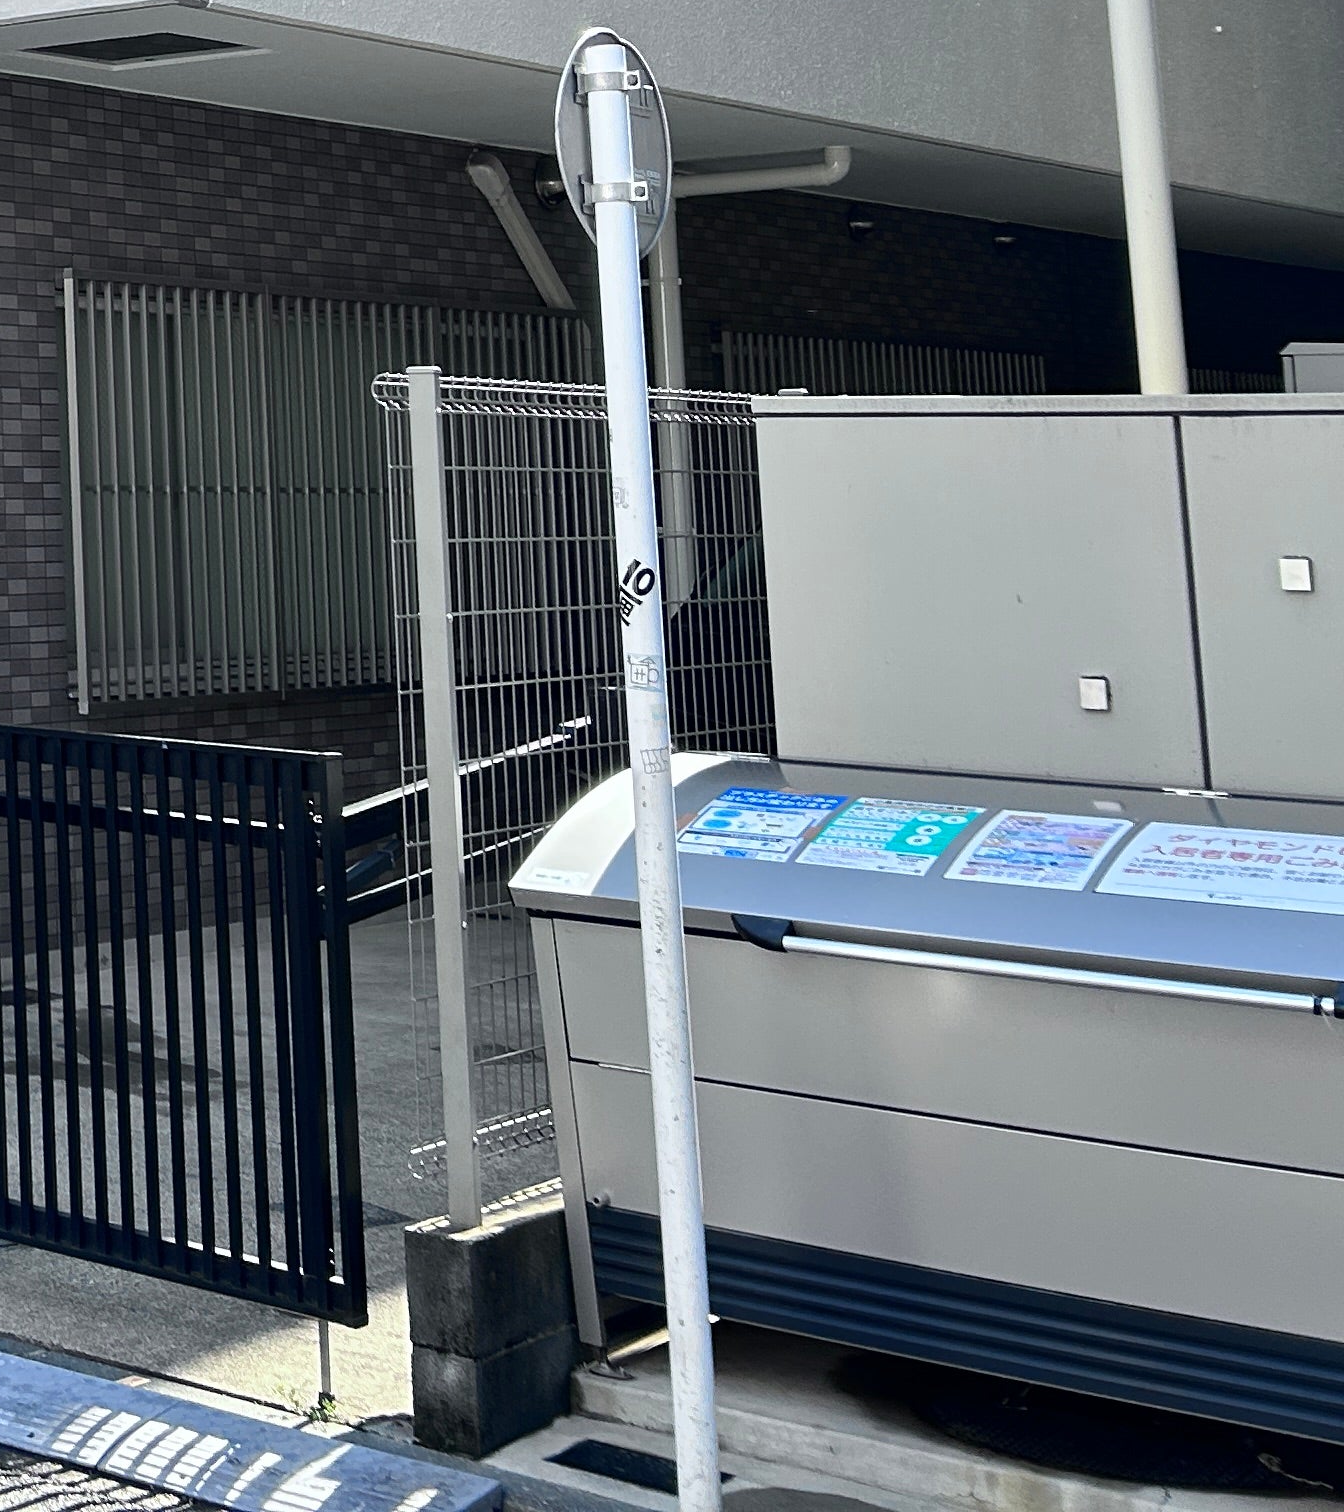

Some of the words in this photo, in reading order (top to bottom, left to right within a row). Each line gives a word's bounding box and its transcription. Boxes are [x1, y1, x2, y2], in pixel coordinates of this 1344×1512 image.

[1141, 844, 1344, 868] 入居者専用ごみ
[1167, 834, 1344, 856] ダイヤモンド
